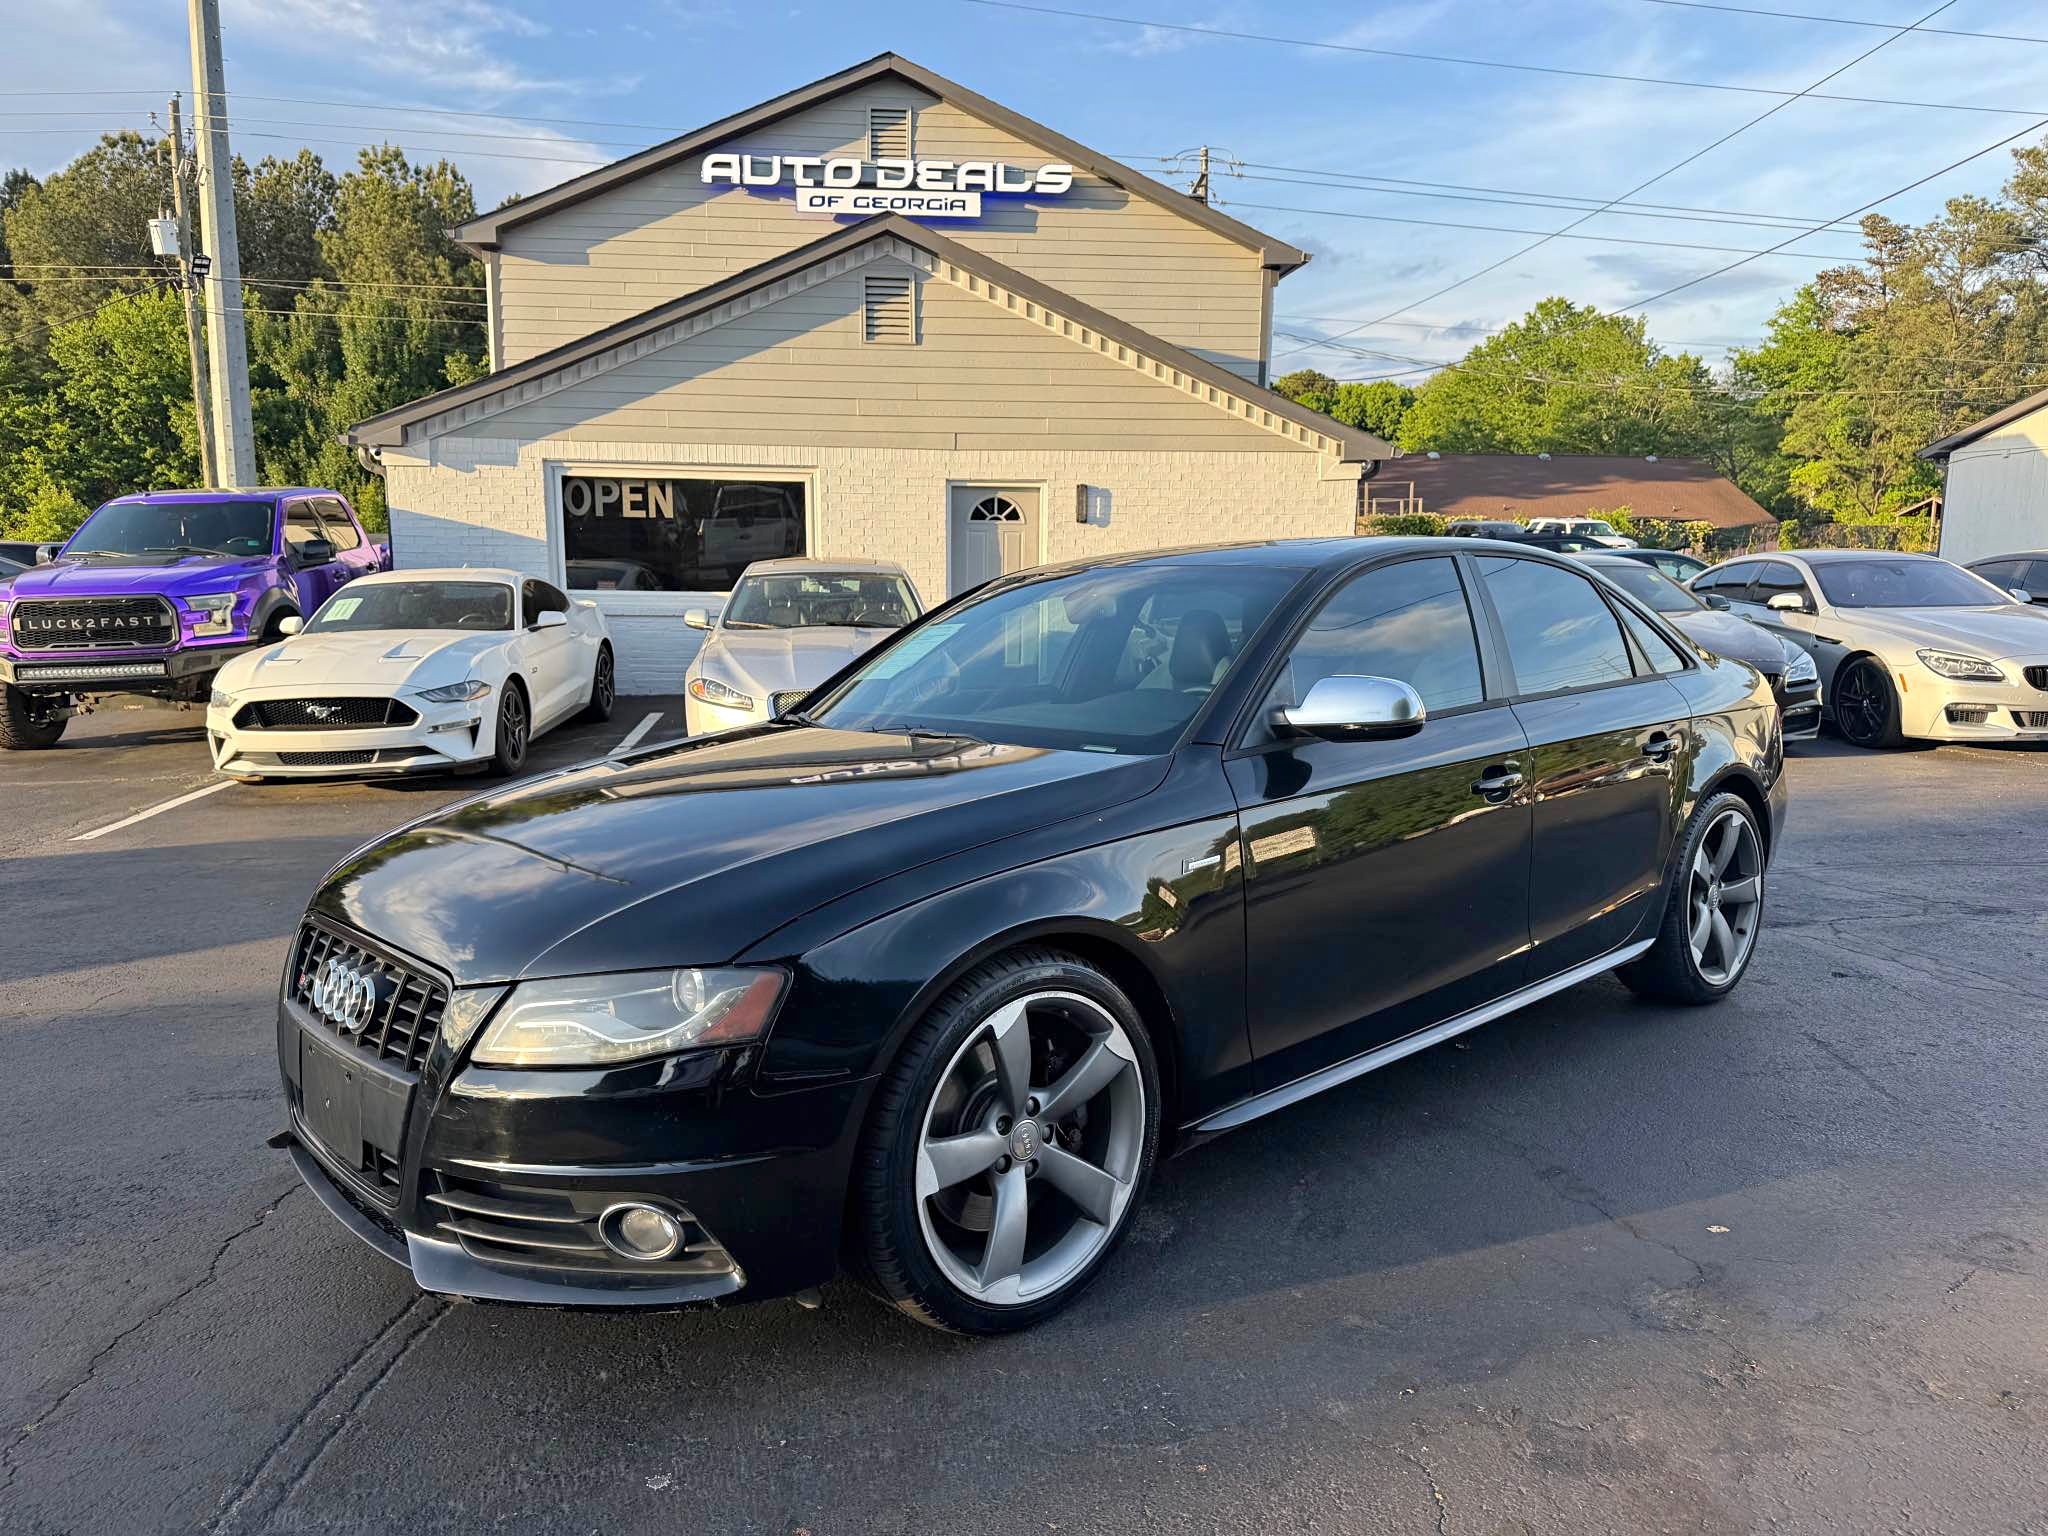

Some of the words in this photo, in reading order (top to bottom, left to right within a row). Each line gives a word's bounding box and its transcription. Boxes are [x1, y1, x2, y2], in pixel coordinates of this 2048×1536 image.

[701, 153, 862, 188] AUTO
[876, 158, 1073, 194] DEALS
[809, 195, 844, 208] OF
[564, 478, 674, 519] OPEN
[28, 616, 154, 630] LUCK2FAST
